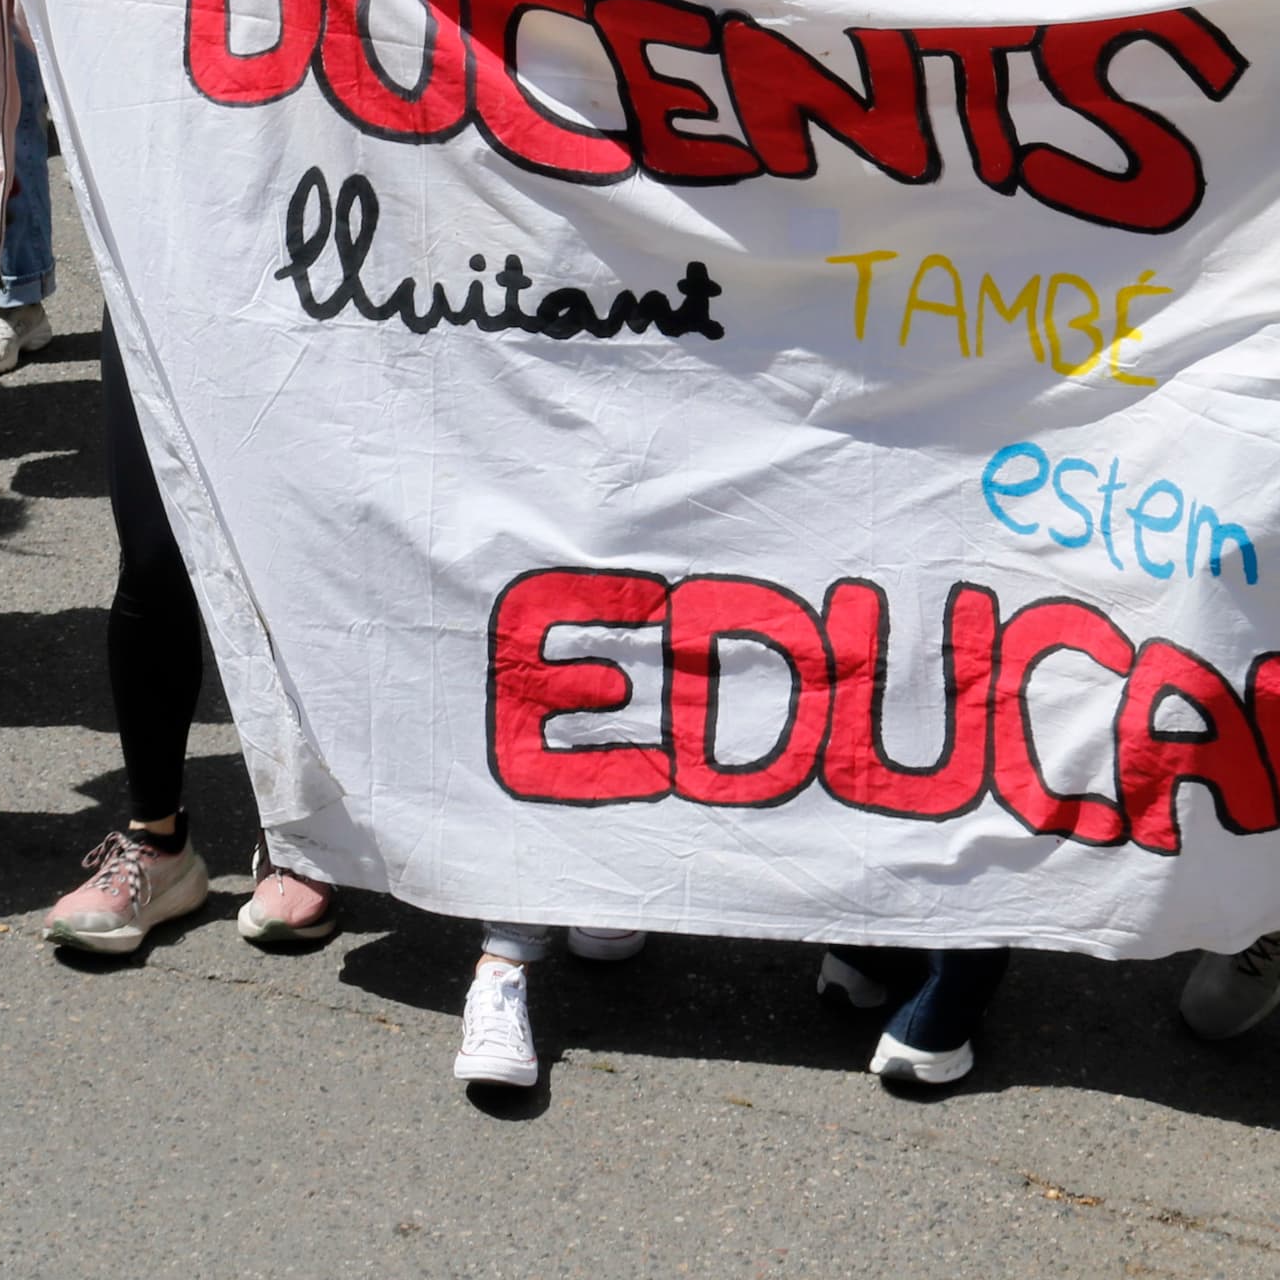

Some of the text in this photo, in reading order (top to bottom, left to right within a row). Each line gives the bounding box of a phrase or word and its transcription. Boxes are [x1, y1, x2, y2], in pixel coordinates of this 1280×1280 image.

[274, 165, 1174, 388] lluitant TAMBÉ
[980, 440, 1260, 586] estem
